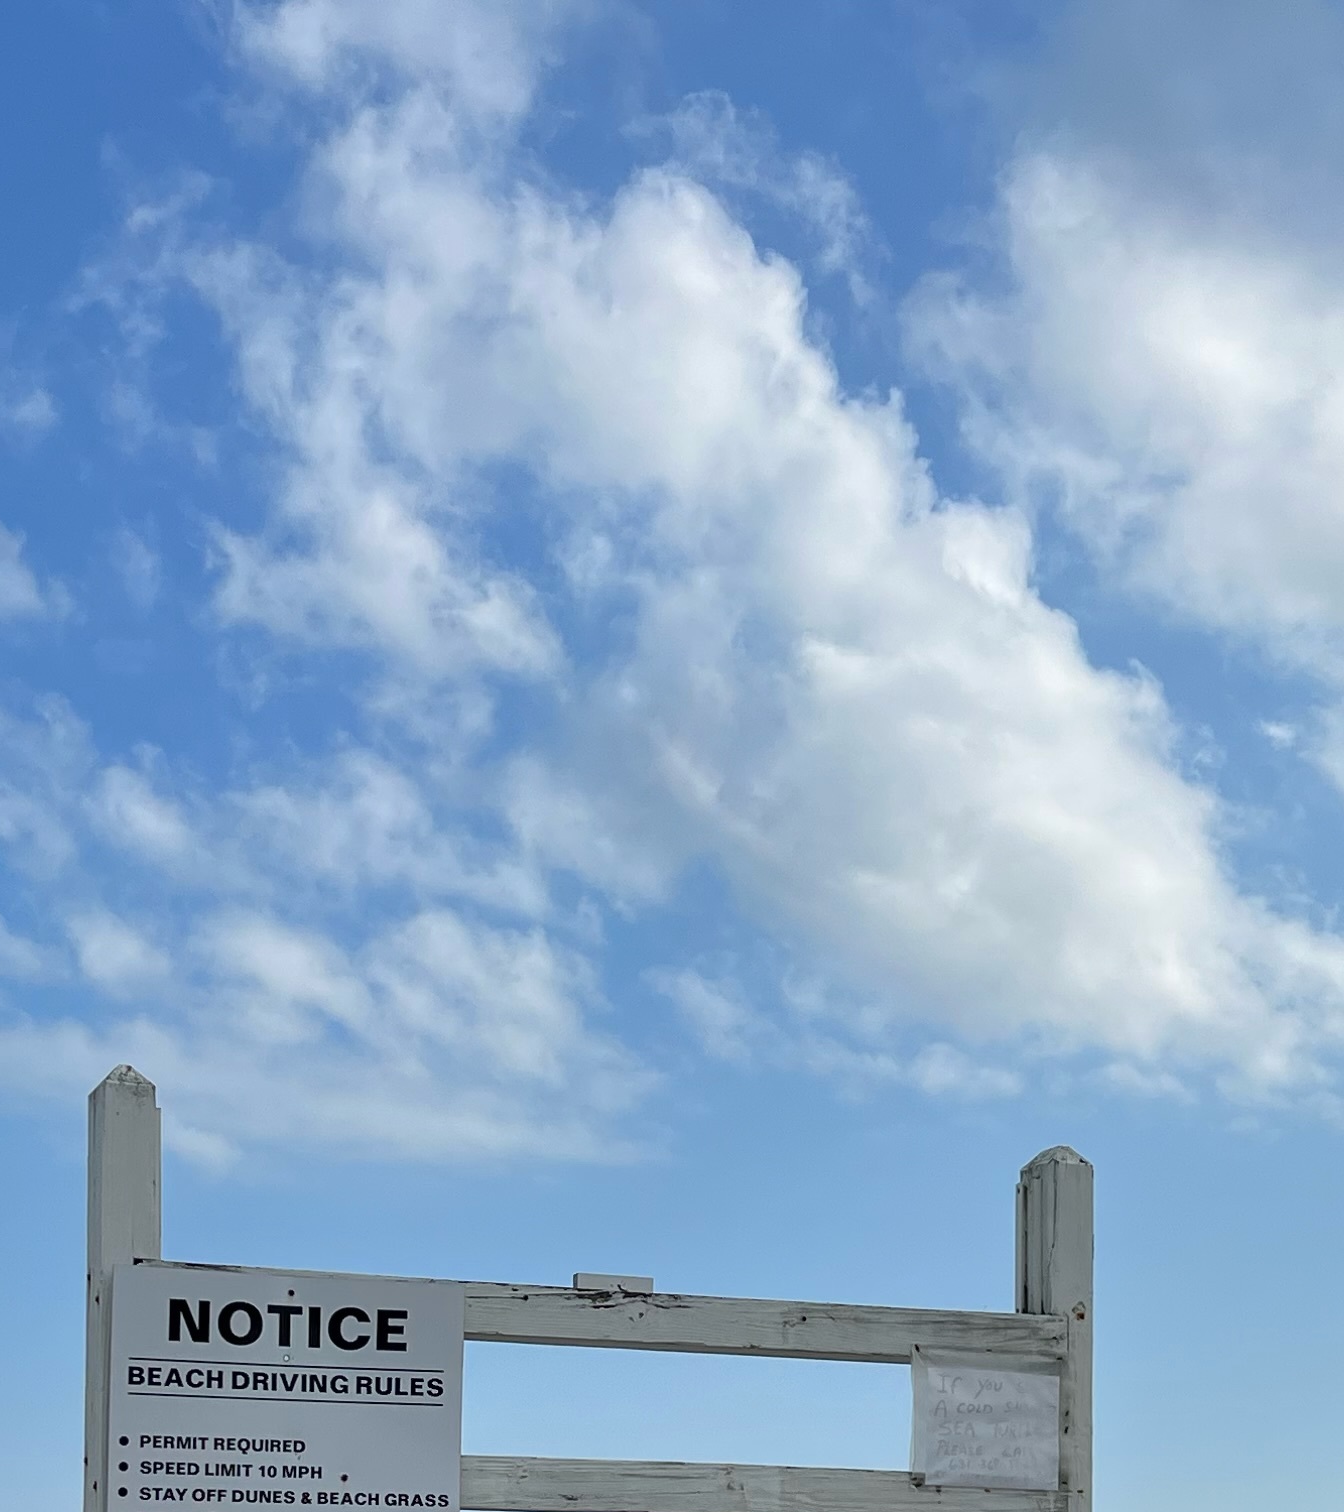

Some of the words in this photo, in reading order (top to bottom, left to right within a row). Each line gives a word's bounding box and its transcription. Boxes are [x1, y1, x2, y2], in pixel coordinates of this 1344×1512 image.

[168, 1298, 408, 1352] NOTICE
[128, 1366, 223, 1389] BEACH
[232, 1371, 348, 1394] DRIVING
[356, 1376, 443, 1397] RULES
[933, 1399, 947, 1418] A
[140, 1435, 209, 1450] PERMIT
[214, 1438, 305, 1455] REQUIRED
[140, 1461, 199, 1475] SPEED
[205, 1463, 253, 1477] LIMIT
[259, 1466, 277, 1478] 10
[282, 1466, 322, 1479] MPH
[139, 1487, 188, 1501] STAY
[192, 1489, 227, 1502] OFF
[232, 1490, 295, 1504] DUNES
[301, 1492, 312, 1504] &
[317, 1492, 379, 1505] BEACH
[385, 1493, 449, 1507] GRASS
